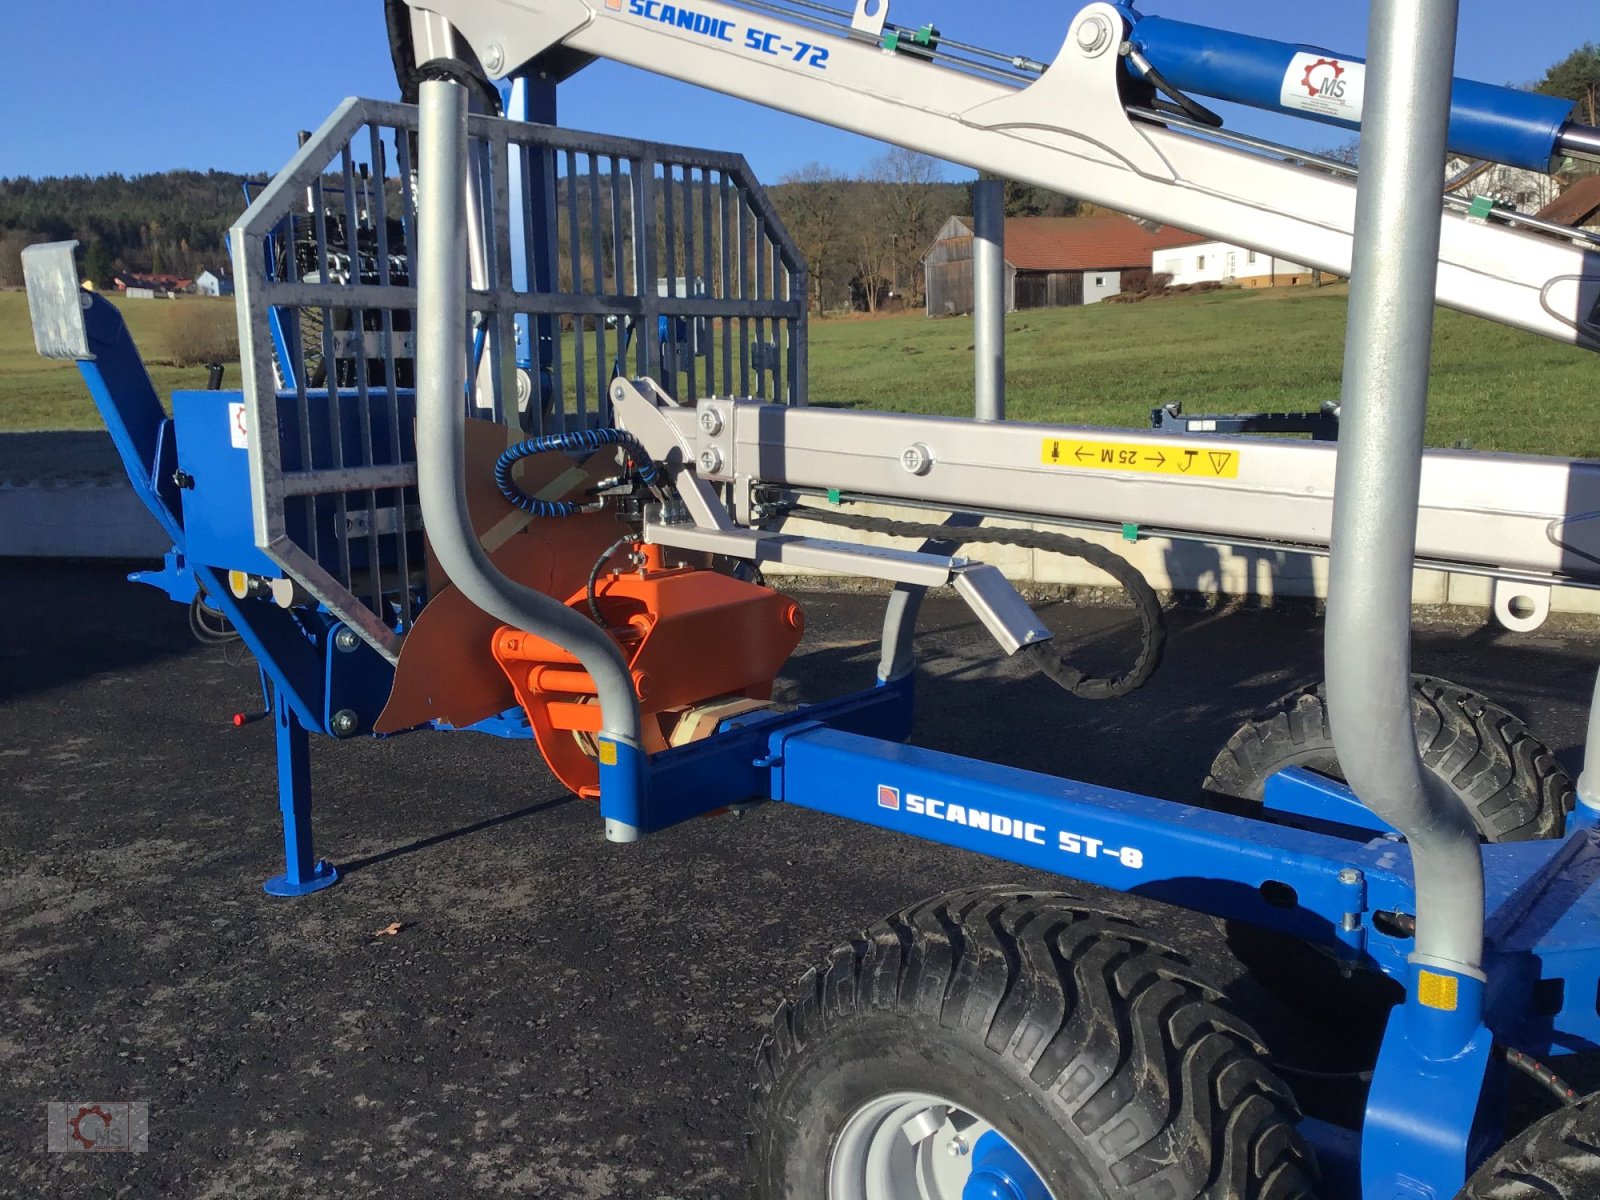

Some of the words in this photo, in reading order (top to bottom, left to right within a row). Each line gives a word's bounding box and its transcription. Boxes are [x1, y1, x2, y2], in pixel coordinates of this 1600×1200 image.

[628, 0, 736, 43] SCANDIC
[744, 27, 830, 70] SC-72
[1101, 448, 1114, 464] M
[1118, 450, 1138, 465] 25
[905, 793, 1046, 845] SCANDIC
[1058, 831, 1144, 870] ST-8
